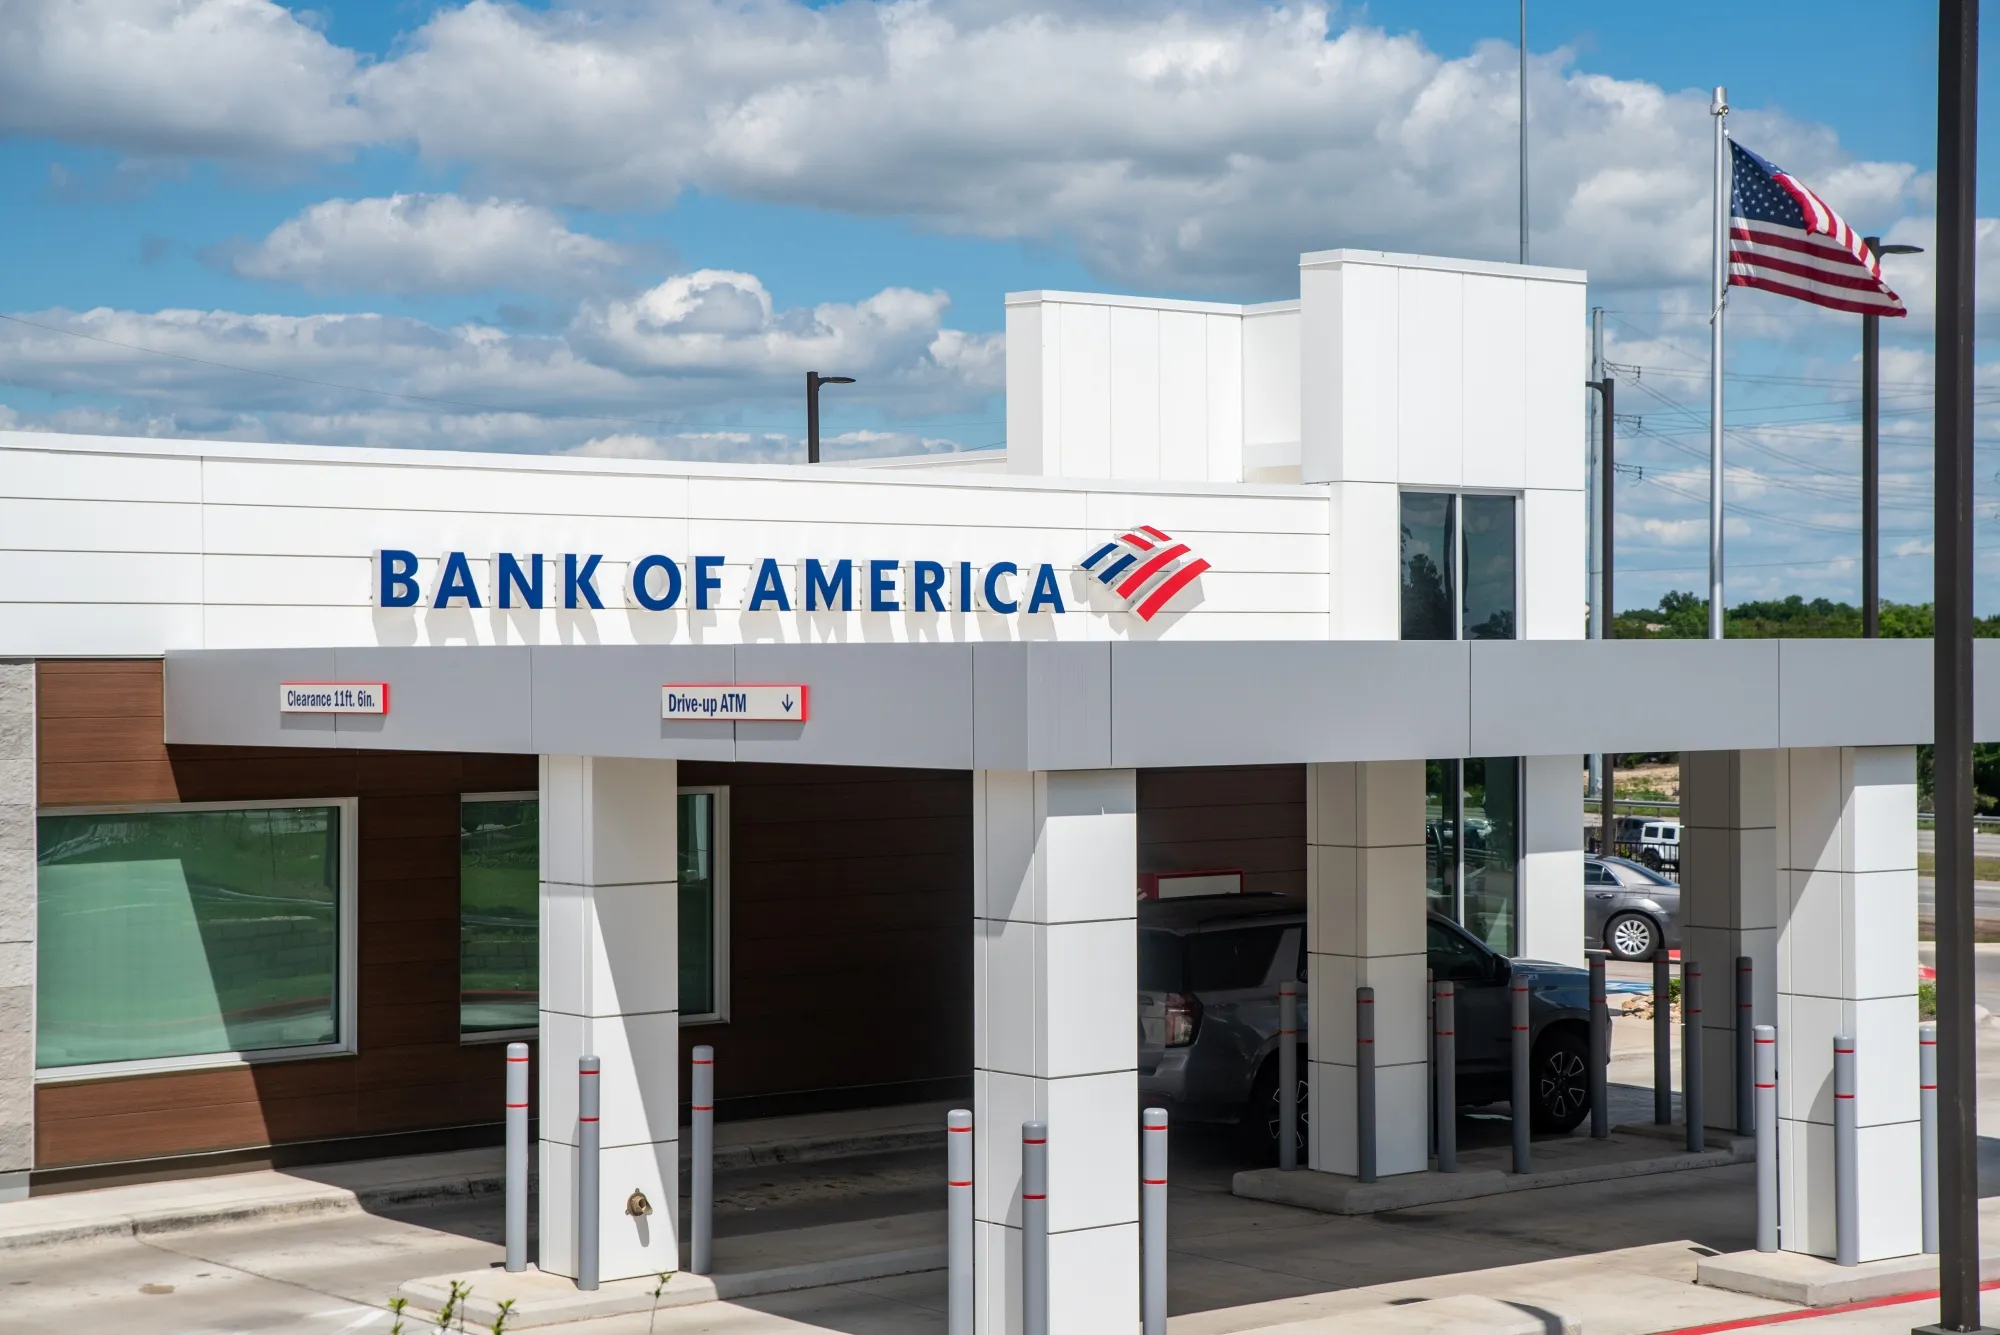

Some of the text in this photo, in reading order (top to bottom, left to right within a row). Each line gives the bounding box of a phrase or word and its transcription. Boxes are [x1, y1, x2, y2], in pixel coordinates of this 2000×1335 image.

[380, 549, 1065, 614] BANK OF AMERICA
[287, 690, 375, 707] Clearance 11ft. 6in.
[668, 693, 747, 717] Drive-up ATM
